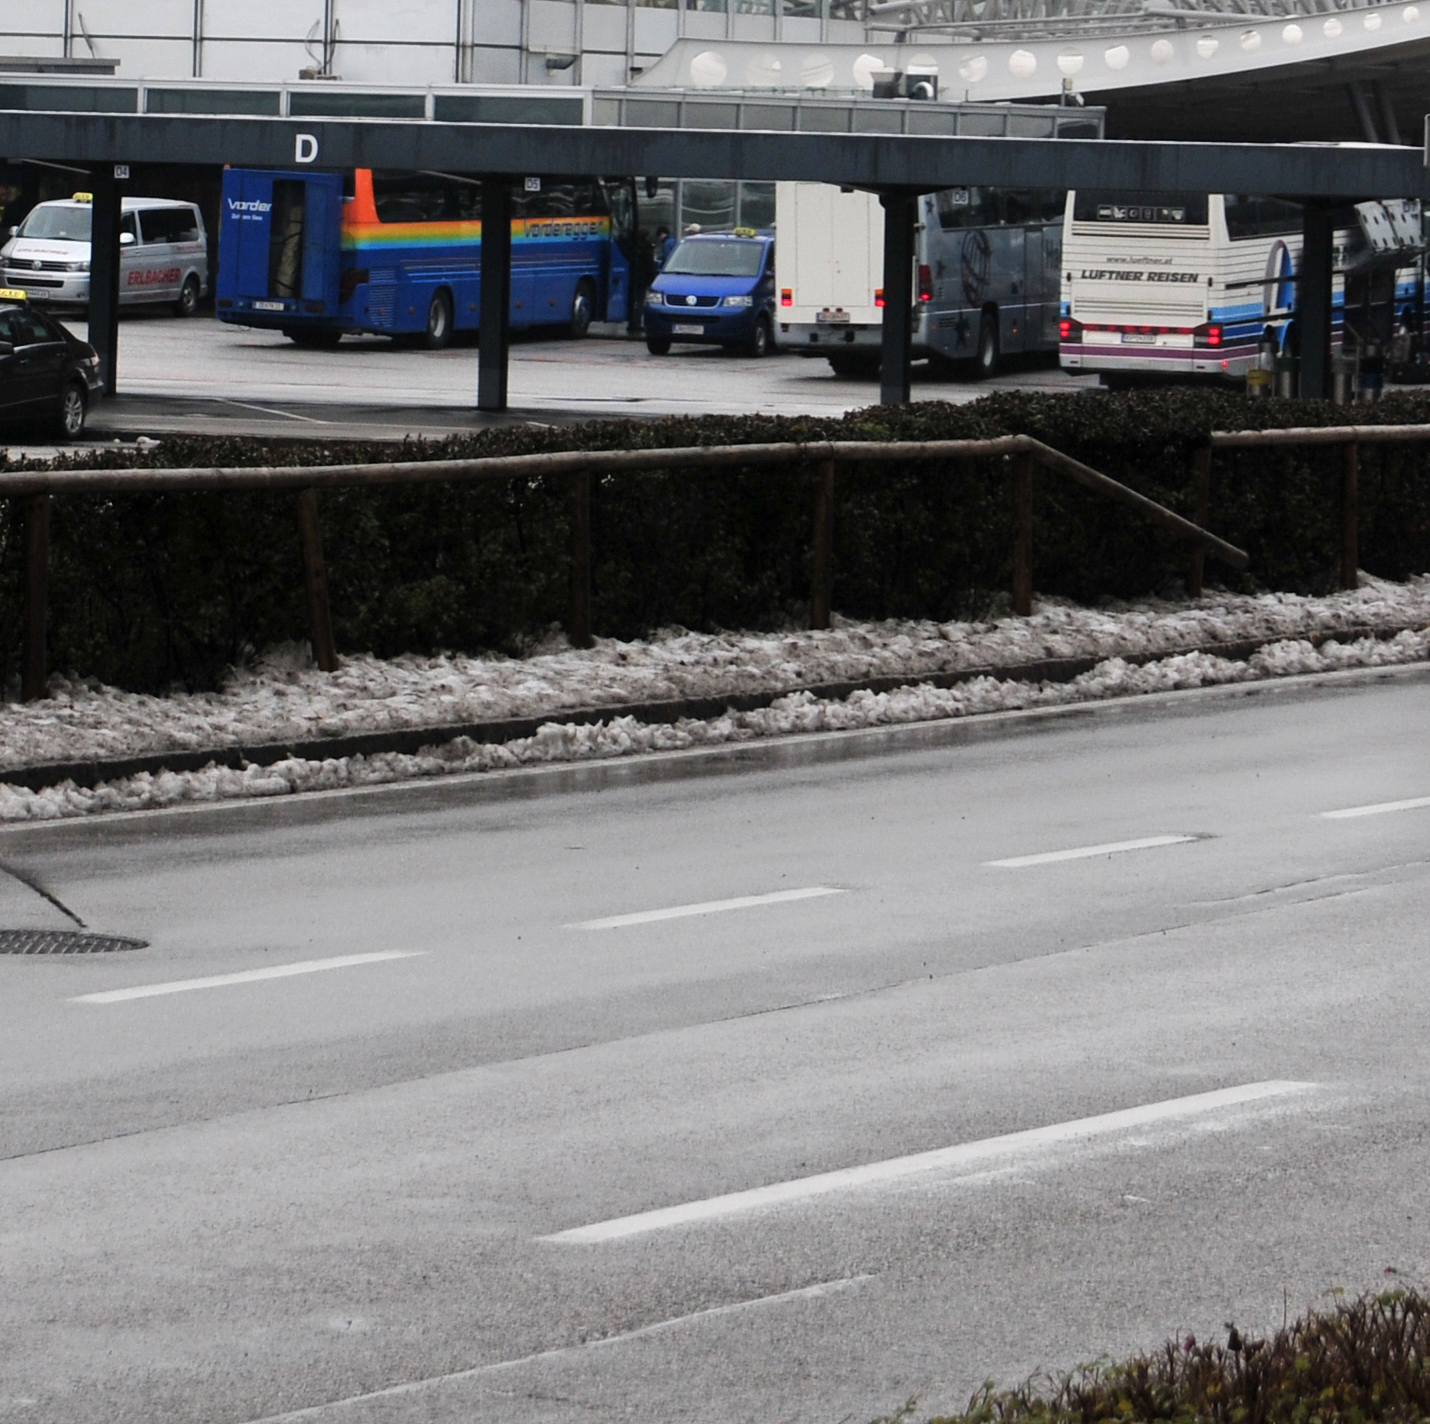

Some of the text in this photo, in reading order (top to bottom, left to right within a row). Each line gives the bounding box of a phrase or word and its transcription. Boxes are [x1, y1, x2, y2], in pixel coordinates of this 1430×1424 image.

[294, 133, 319, 163] D
[127, 267, 182, 286] ERLBACHER
[1147, 271, 1199, 284] REISEN
